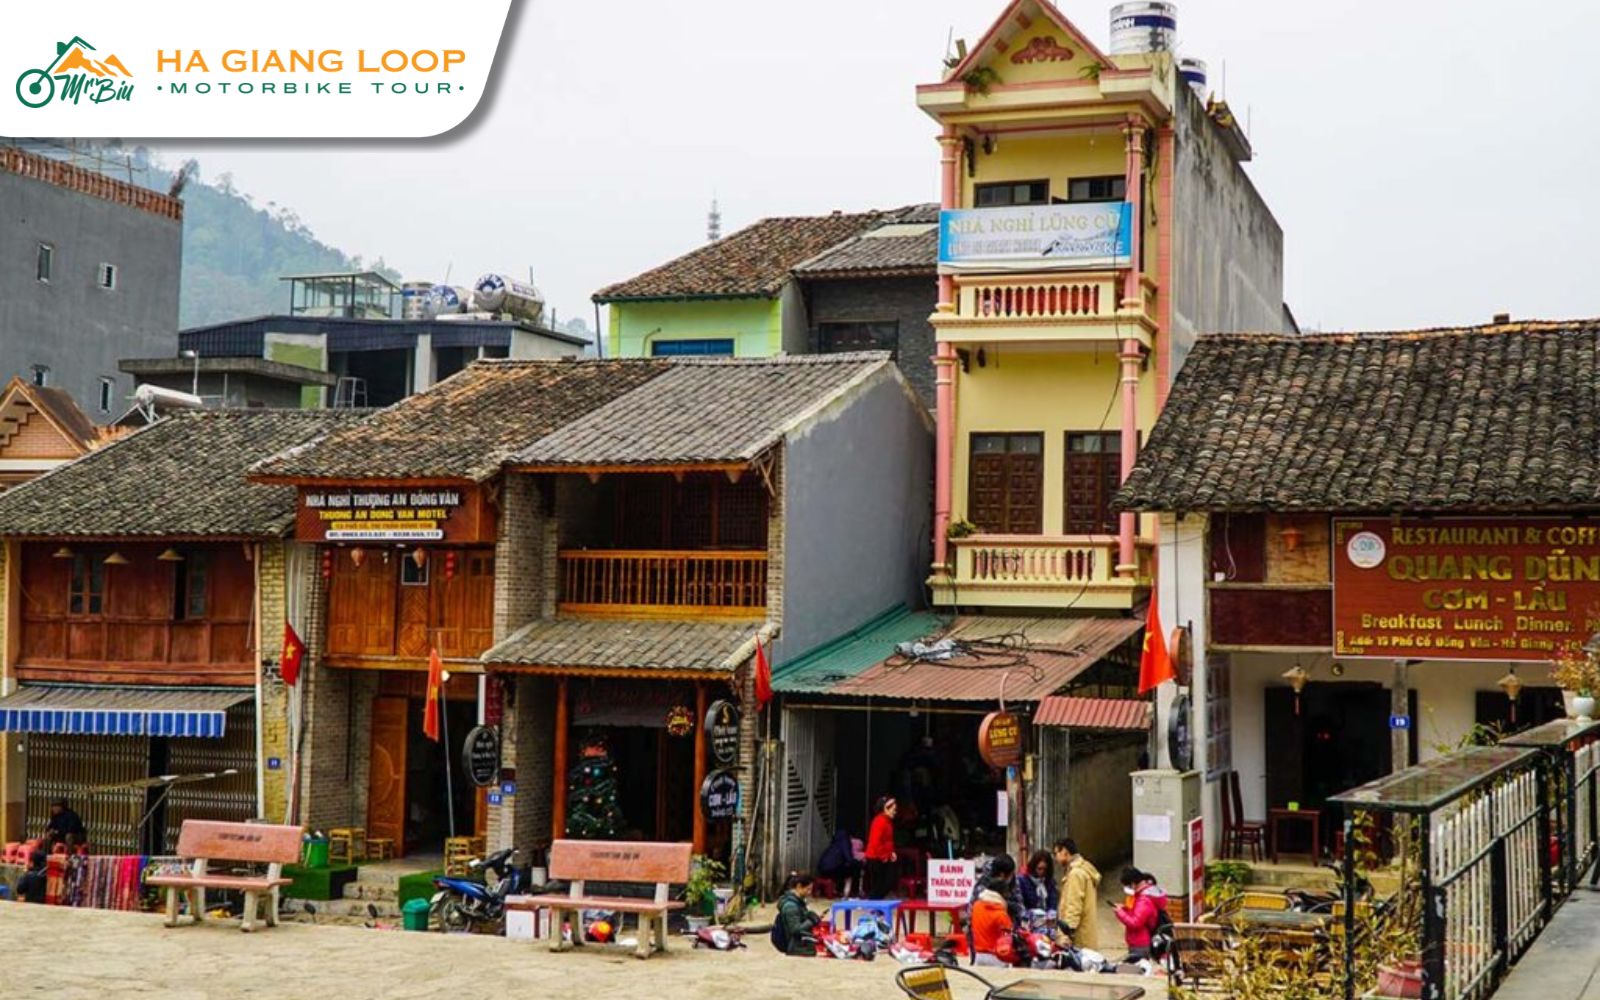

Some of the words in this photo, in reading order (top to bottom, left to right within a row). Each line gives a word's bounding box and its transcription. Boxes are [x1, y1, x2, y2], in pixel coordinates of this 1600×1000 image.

[392, 494, 407, 506] AN
[355, 510, 367, 519] AN
[417, 509, 447, 519] MOTEL
[1392, 527, 1519, 545] RESTAURANT
[1525, 528, 1540, 544] &
[1388, 555, 1513, 583] QUANG
[1362, 614, 1442, 629] Breakfast
[1453, 615, 1503, 632] Lunch
